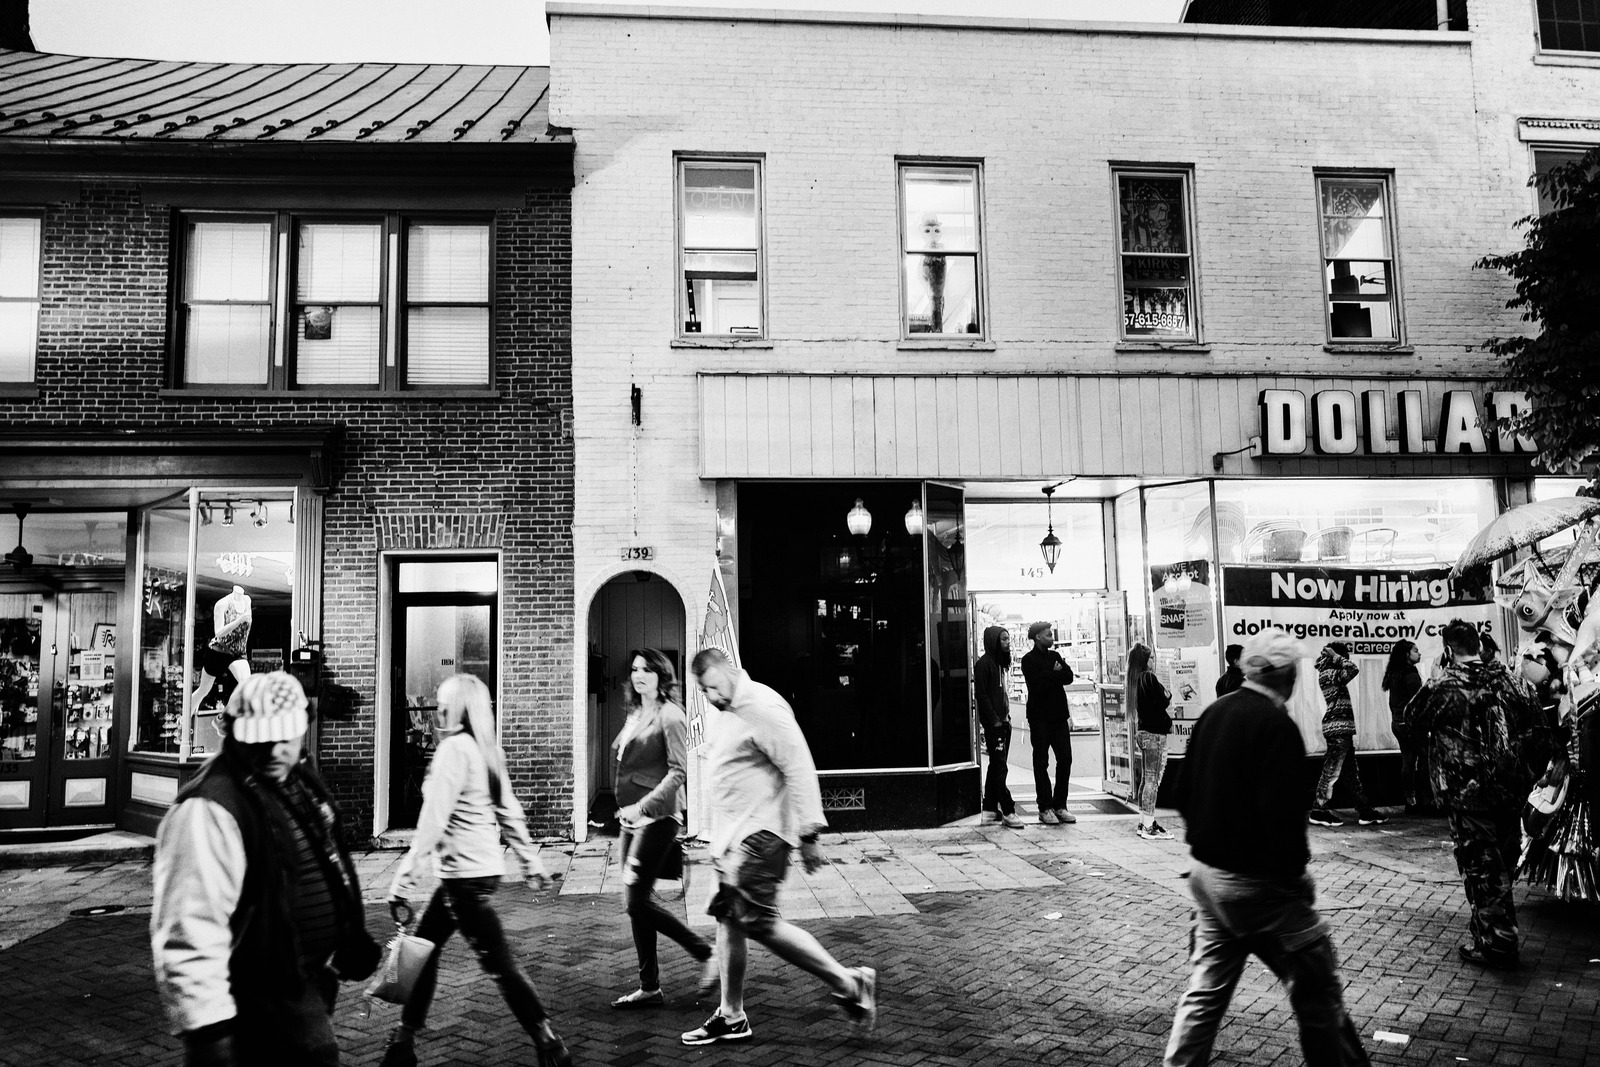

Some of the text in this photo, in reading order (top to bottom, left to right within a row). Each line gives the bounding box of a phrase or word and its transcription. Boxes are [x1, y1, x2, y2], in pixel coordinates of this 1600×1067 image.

[690, 191, 745, 210] OPEN
[1137, 257, 1181, 270] KIRK'S
[1260, 388, 1540, 455] DOLLAR
[628, 547, 649, 559] 139
[1020, 567, 1044, 578] 145
[1172, 562, 1187, 572] WE
[1270, 572, 1456, 607] Now Hiring!
[1160, 613, 1185, 624] SNAP
[1328, 610, 1406, 622] Apply now at
[1233, 619, 1492, 640] dolrgeneral.com/cars
[1355, 642, 1397, 653] career
[1174, 724, 1194, 736] Mar
